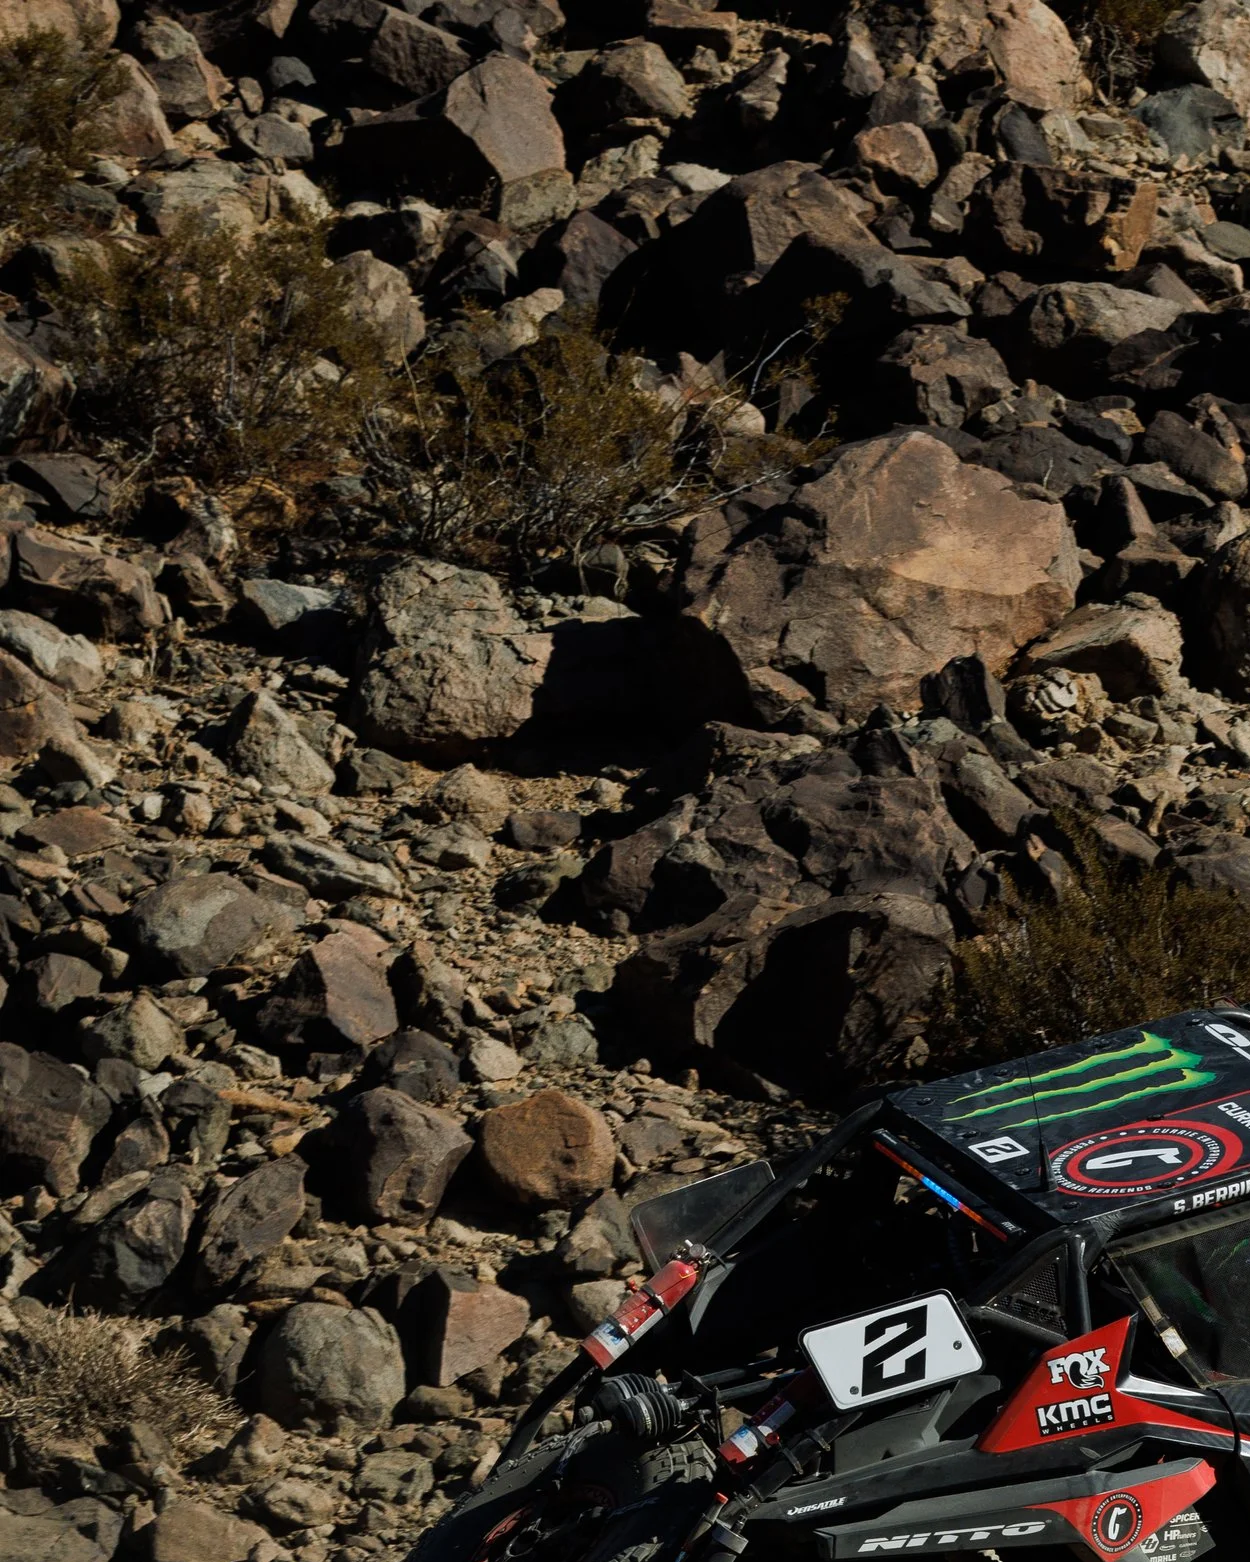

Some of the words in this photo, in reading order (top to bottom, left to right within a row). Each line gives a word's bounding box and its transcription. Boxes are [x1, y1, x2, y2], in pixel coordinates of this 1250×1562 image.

[1152, 1128, 1198, 1138] CURRIE
[1088, 1185, 1153, 1194] REARENDS
[862, 1305, 928, 1397] 2
[1047, 1347, 1111, 1389] FOX
[1037, 1393, 1112, 1427] KMC
[1042, 1414, 1114, 1435] WHEELS
[857, 1521, 1047, 1553] NITTO
[1150, 1554, 1177, 1562] MAHLE
